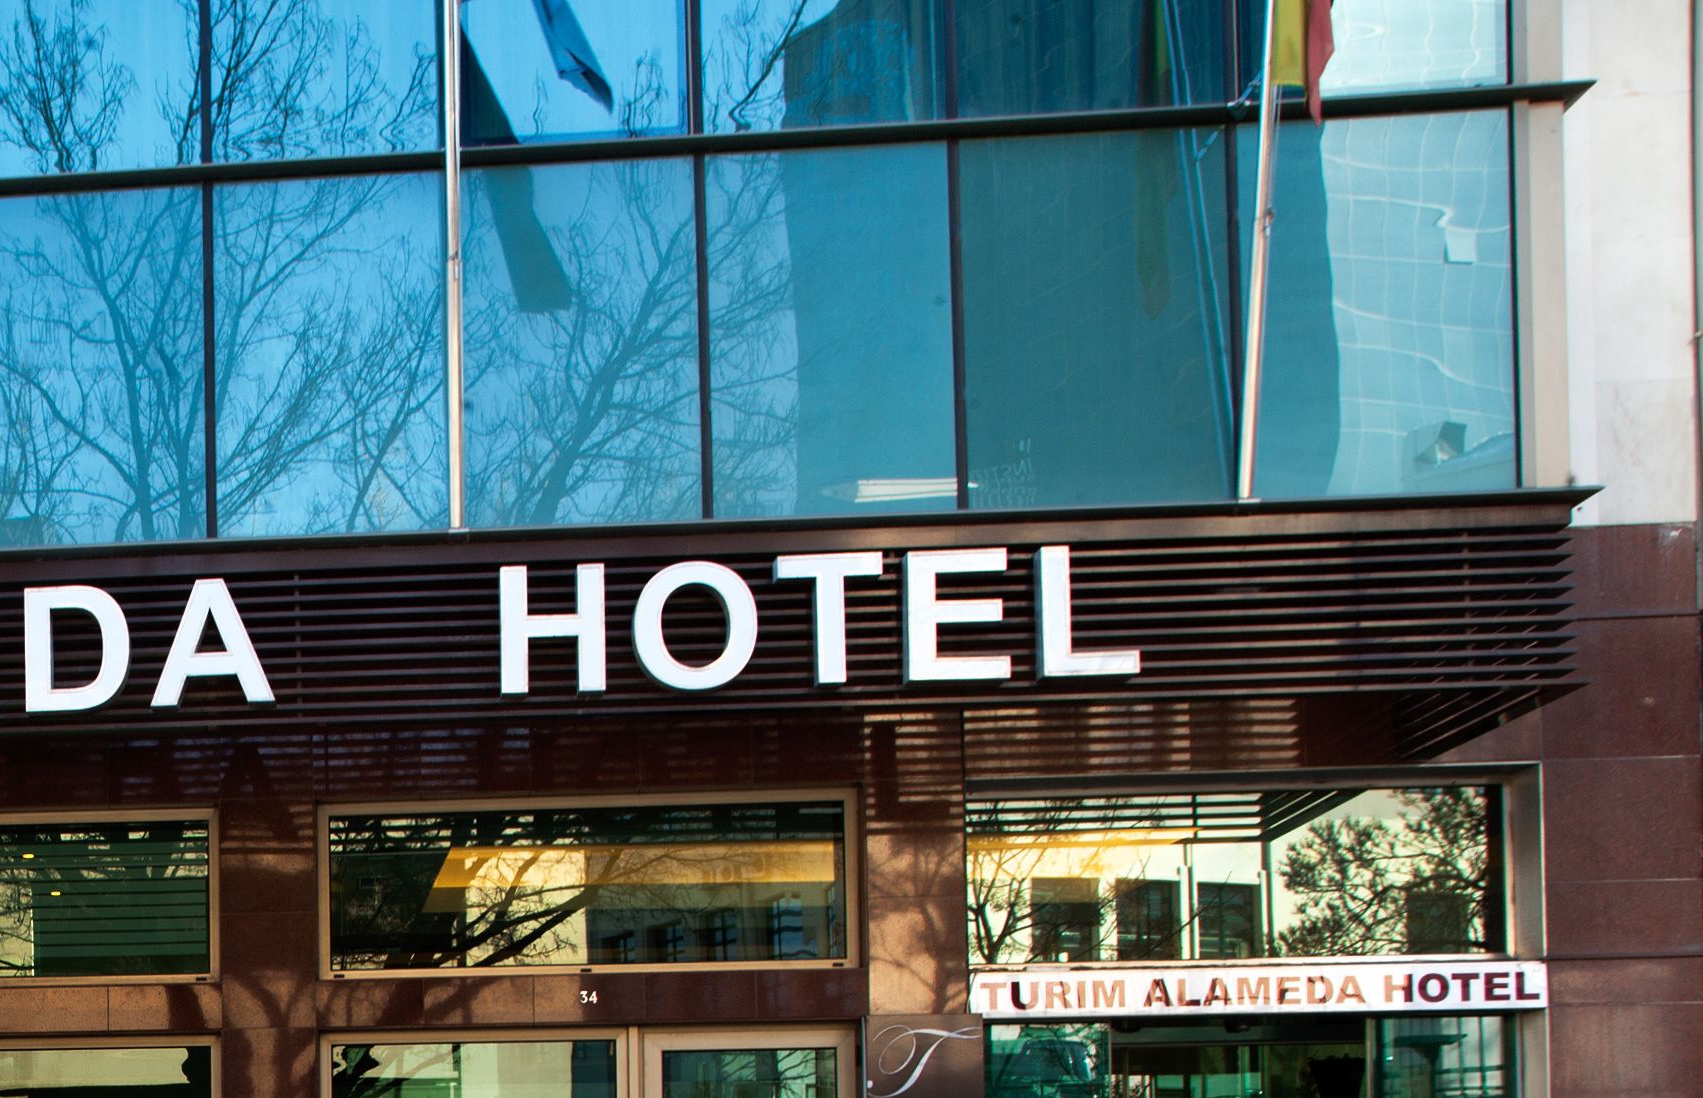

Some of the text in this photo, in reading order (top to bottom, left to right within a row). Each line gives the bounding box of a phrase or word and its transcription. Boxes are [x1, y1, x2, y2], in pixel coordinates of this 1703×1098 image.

[499, 545, 1141, 697] HOTEL
[579, 990, 598, 1004] 34
[980, 971, 1541, 1012] TURIM ALAMEDA HOTEL
